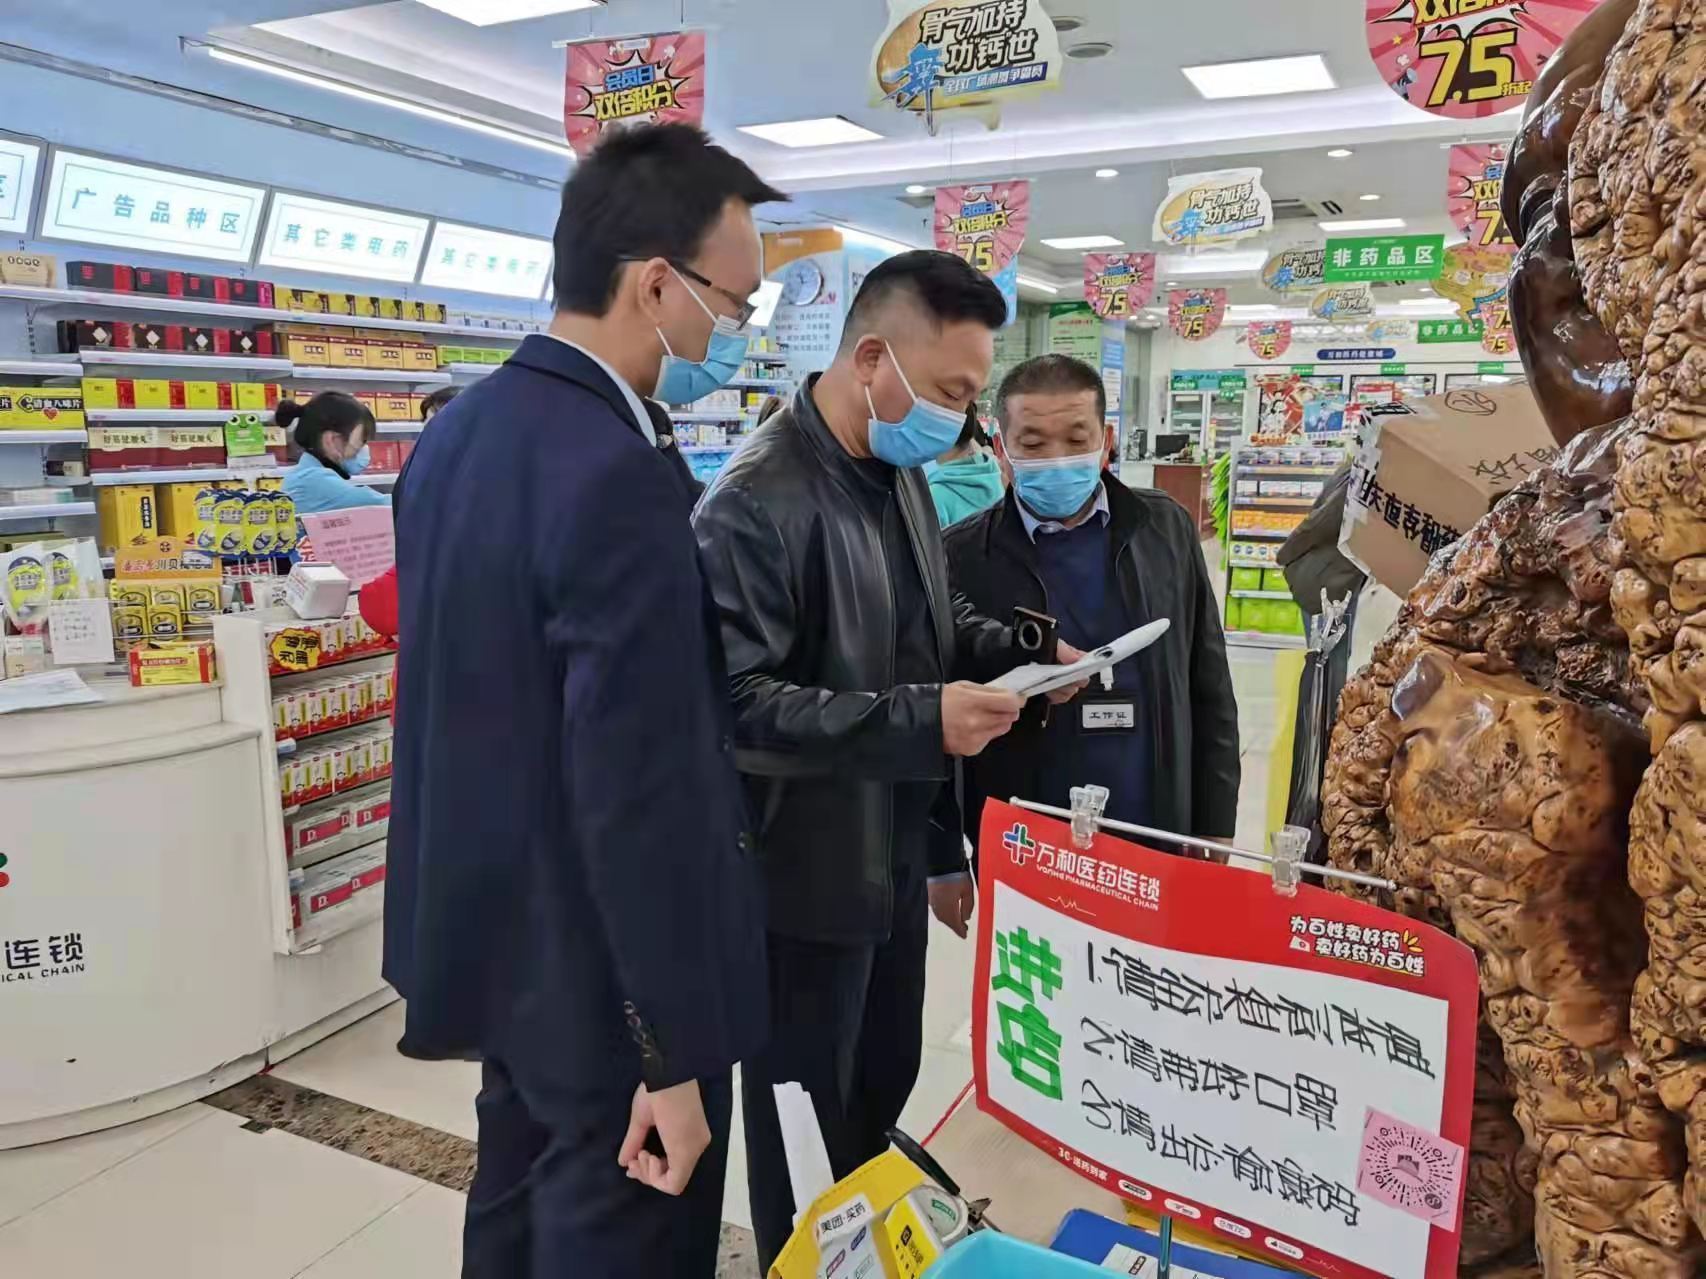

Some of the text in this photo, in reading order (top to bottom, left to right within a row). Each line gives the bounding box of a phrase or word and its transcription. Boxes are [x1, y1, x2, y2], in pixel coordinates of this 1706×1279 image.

[922, 1, 1025, 43] 骨气加持
[605, 66, 655, 92] 会员日
[1421, 30, 1516, 107] 7.5
[594, 81, 673, 121] 双倍积分
[71, 186, 241, 234] 广告品种区
[284, 222, 410, 259] 其它类用药
[1332, 245, 1435, 268] 非药品区
[1089, 711, 1127, 720] 工作证
[1037, 842, 1160, 902] 万和医药连锁
[1133, 897, 1159, 912] CHAIN
[1290, 915, 1400, 950] 为百姓卖好药
[5, 933, 83, 970] 连锁
[1315, 937, 1424, 974] 卖好药为百姓
[41, 963, 86, 979] CHAIN
[991, 926, 1064, 1101] 进店
